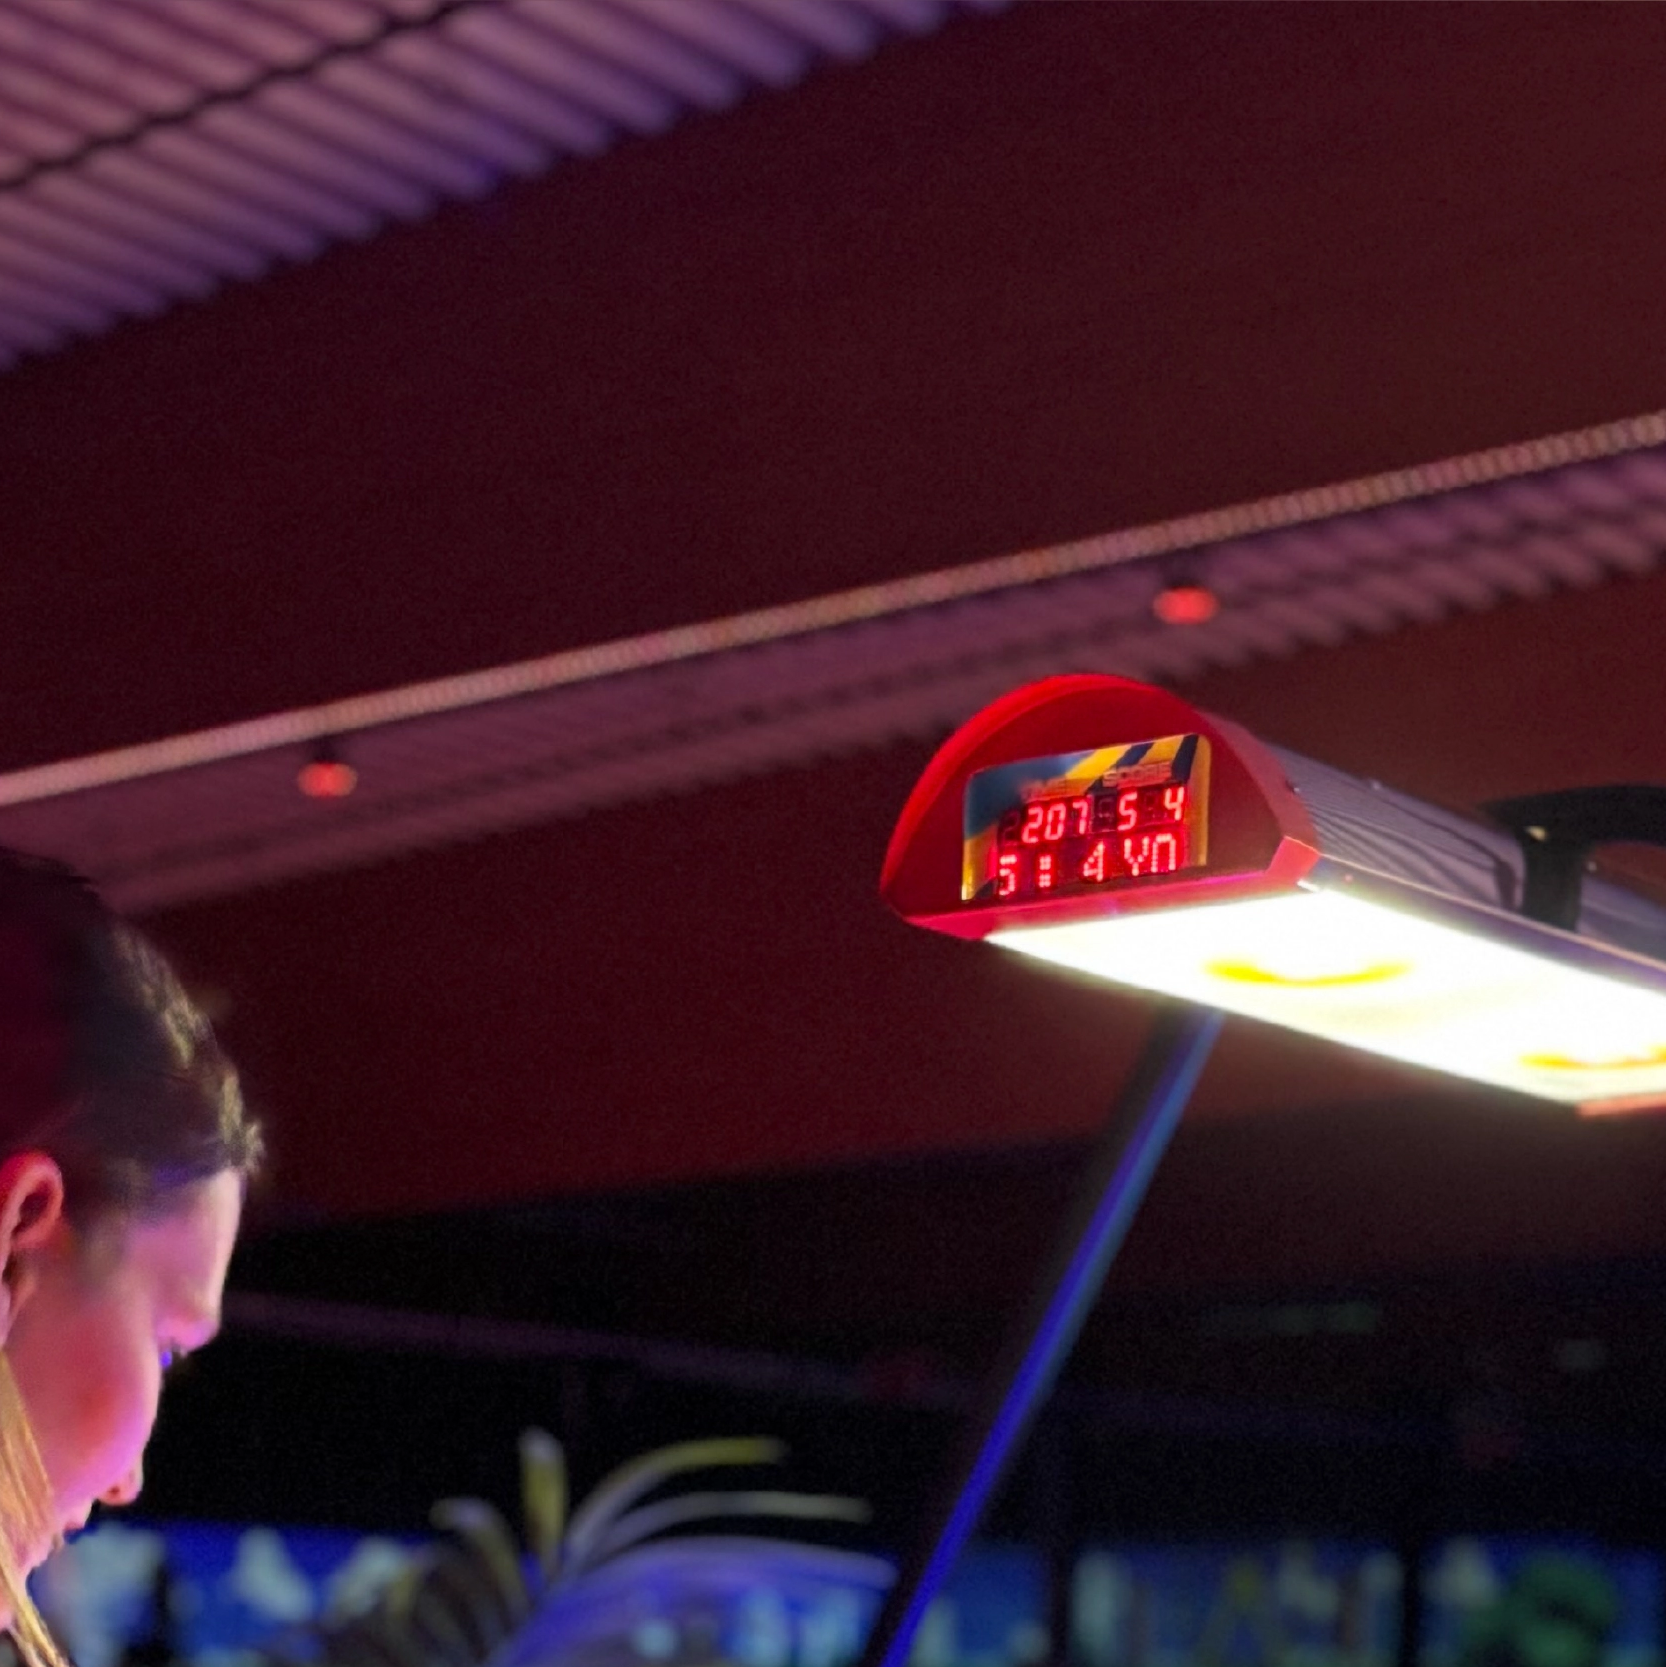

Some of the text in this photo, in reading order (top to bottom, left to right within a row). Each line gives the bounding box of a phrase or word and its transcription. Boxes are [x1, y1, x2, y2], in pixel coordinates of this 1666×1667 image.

[1118, 791, 1138, 832] 5
[1164, 786, 1185, 822] 4
[1083, 838, 1105, 883] 4
